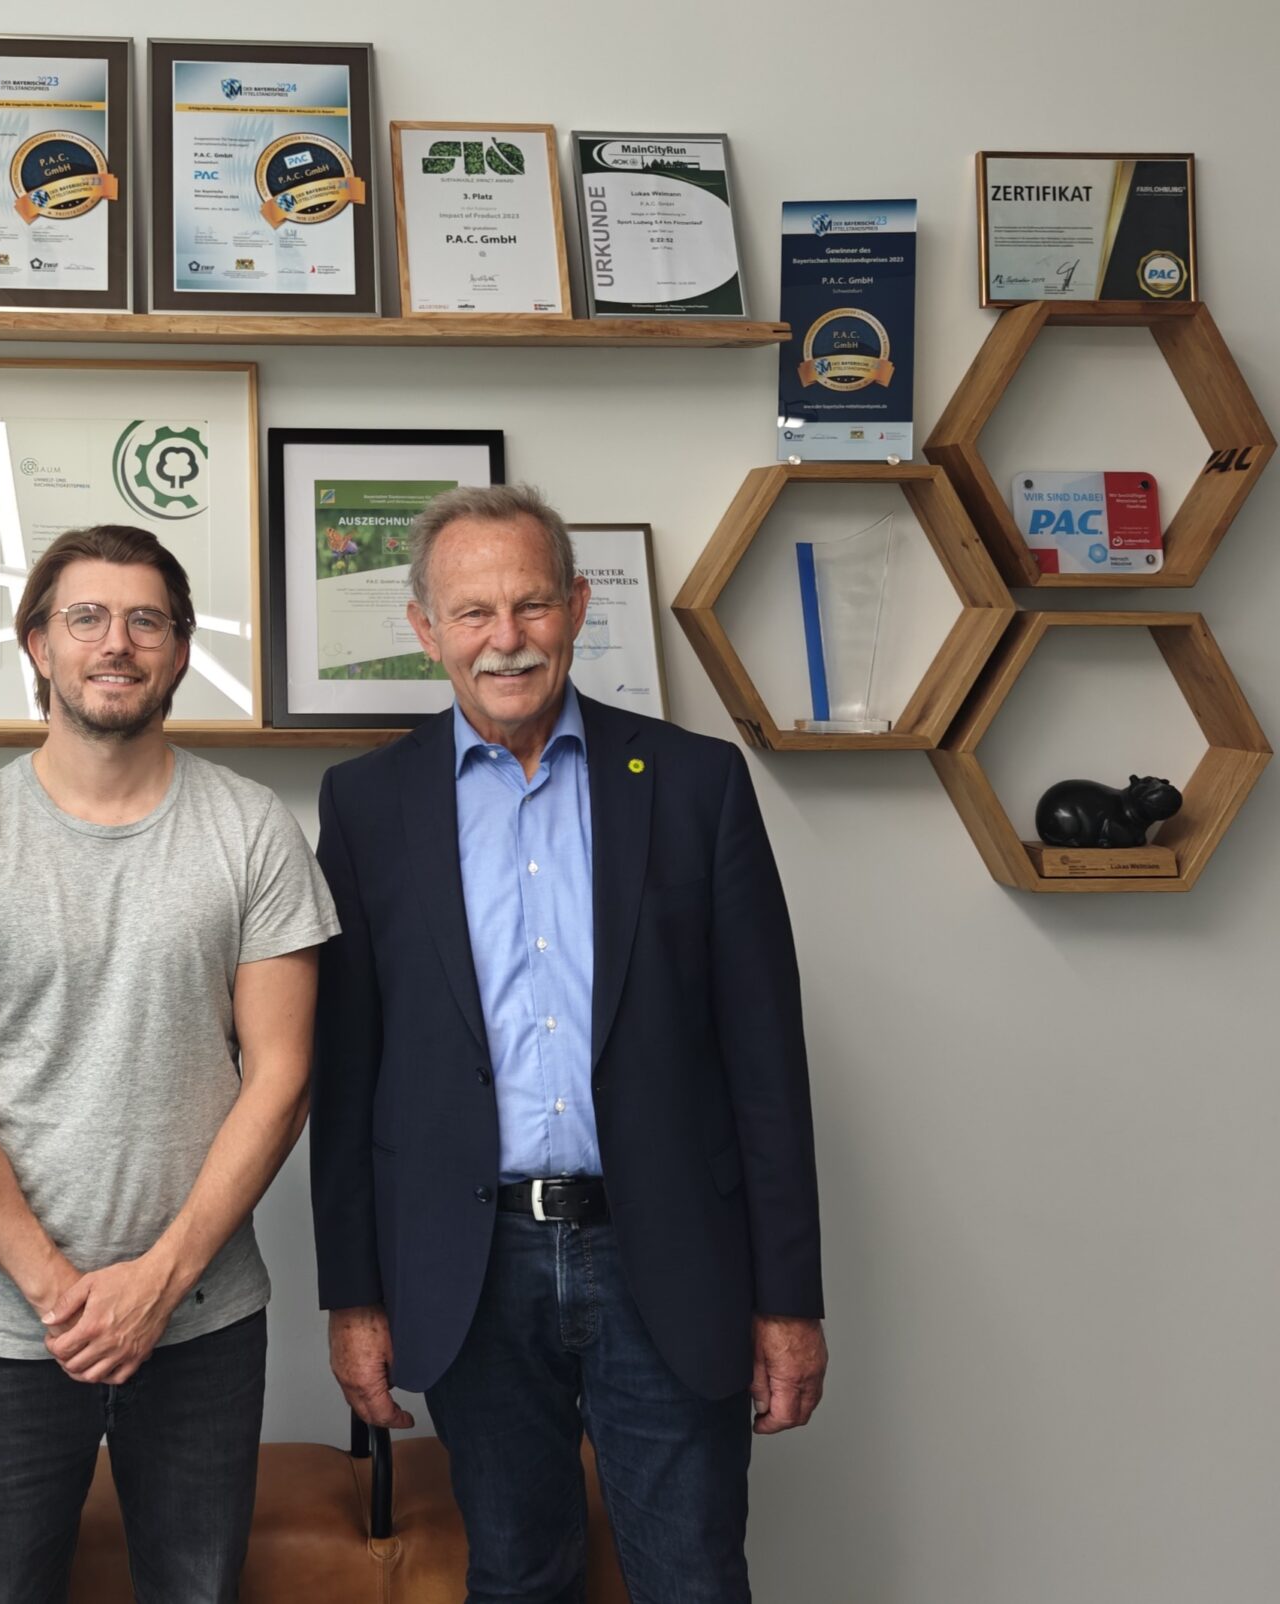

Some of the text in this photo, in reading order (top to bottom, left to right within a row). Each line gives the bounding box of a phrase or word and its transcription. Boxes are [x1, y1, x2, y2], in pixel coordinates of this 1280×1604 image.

[621, 145, 686, 156] MainCityRun
[39, 152, 70, 168] P.A.C.
[43, 163, 72, 177] GmbH
[194, 170, 219, 180] PAC
[304, 163, 330, 177] GmbH
[991, 184, 1093, 202] ZERTIFIKAT
[446, 234, 517, 244] P.A.C. GmbH
[588, 186, 614, 287] URKUNDE
[792, 257, 828, 265] Bayerischen
[1148, 268, 1177, 280] PAC
[822, 276, 873, 285] P.A.C. GmbH
[832, 330, 860, 339] P.A.C.
[833, 341, 859, 349] GmbH
[1024, 493, 1104, 502] WIR SIND DABEI
[338, 516, 416, 526] AUSZEICHNUN
[1029, 509, 1103, 535] P.A.C.
